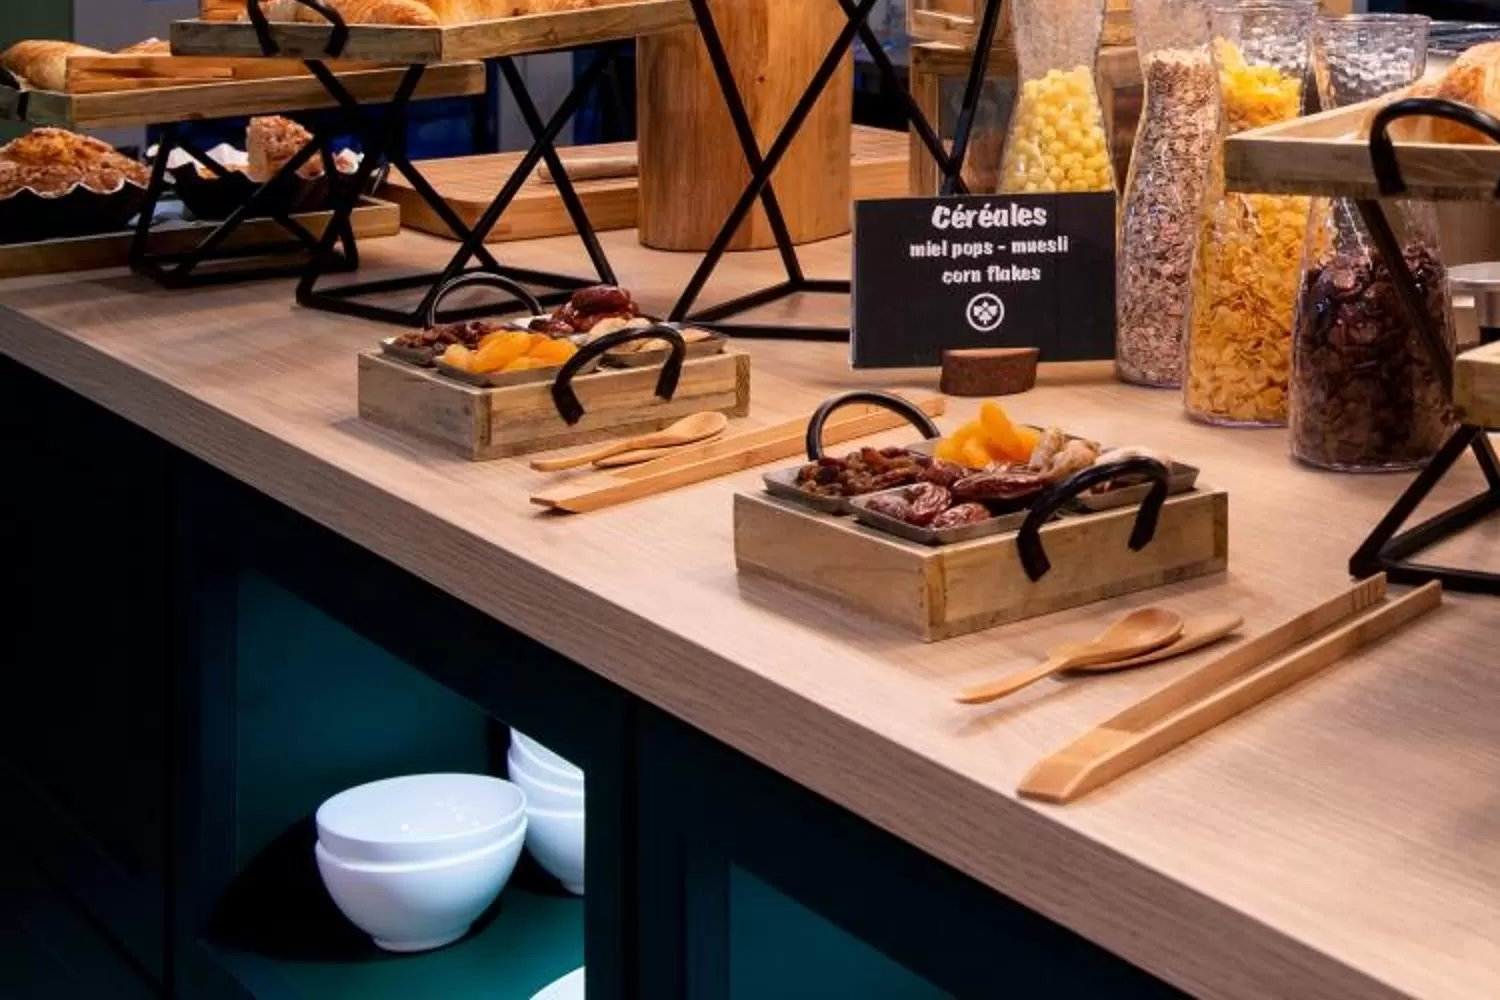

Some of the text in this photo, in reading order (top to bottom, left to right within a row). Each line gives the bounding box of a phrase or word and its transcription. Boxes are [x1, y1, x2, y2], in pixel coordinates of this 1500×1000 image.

[931, 202, 1048, 230] Céréales
[909, 239, 948, 258] miel
[951, 240, 994, 260] pops
[1011, 235, 1069, 255] muesli
[941, 264, 1041, 285] corn flakes
